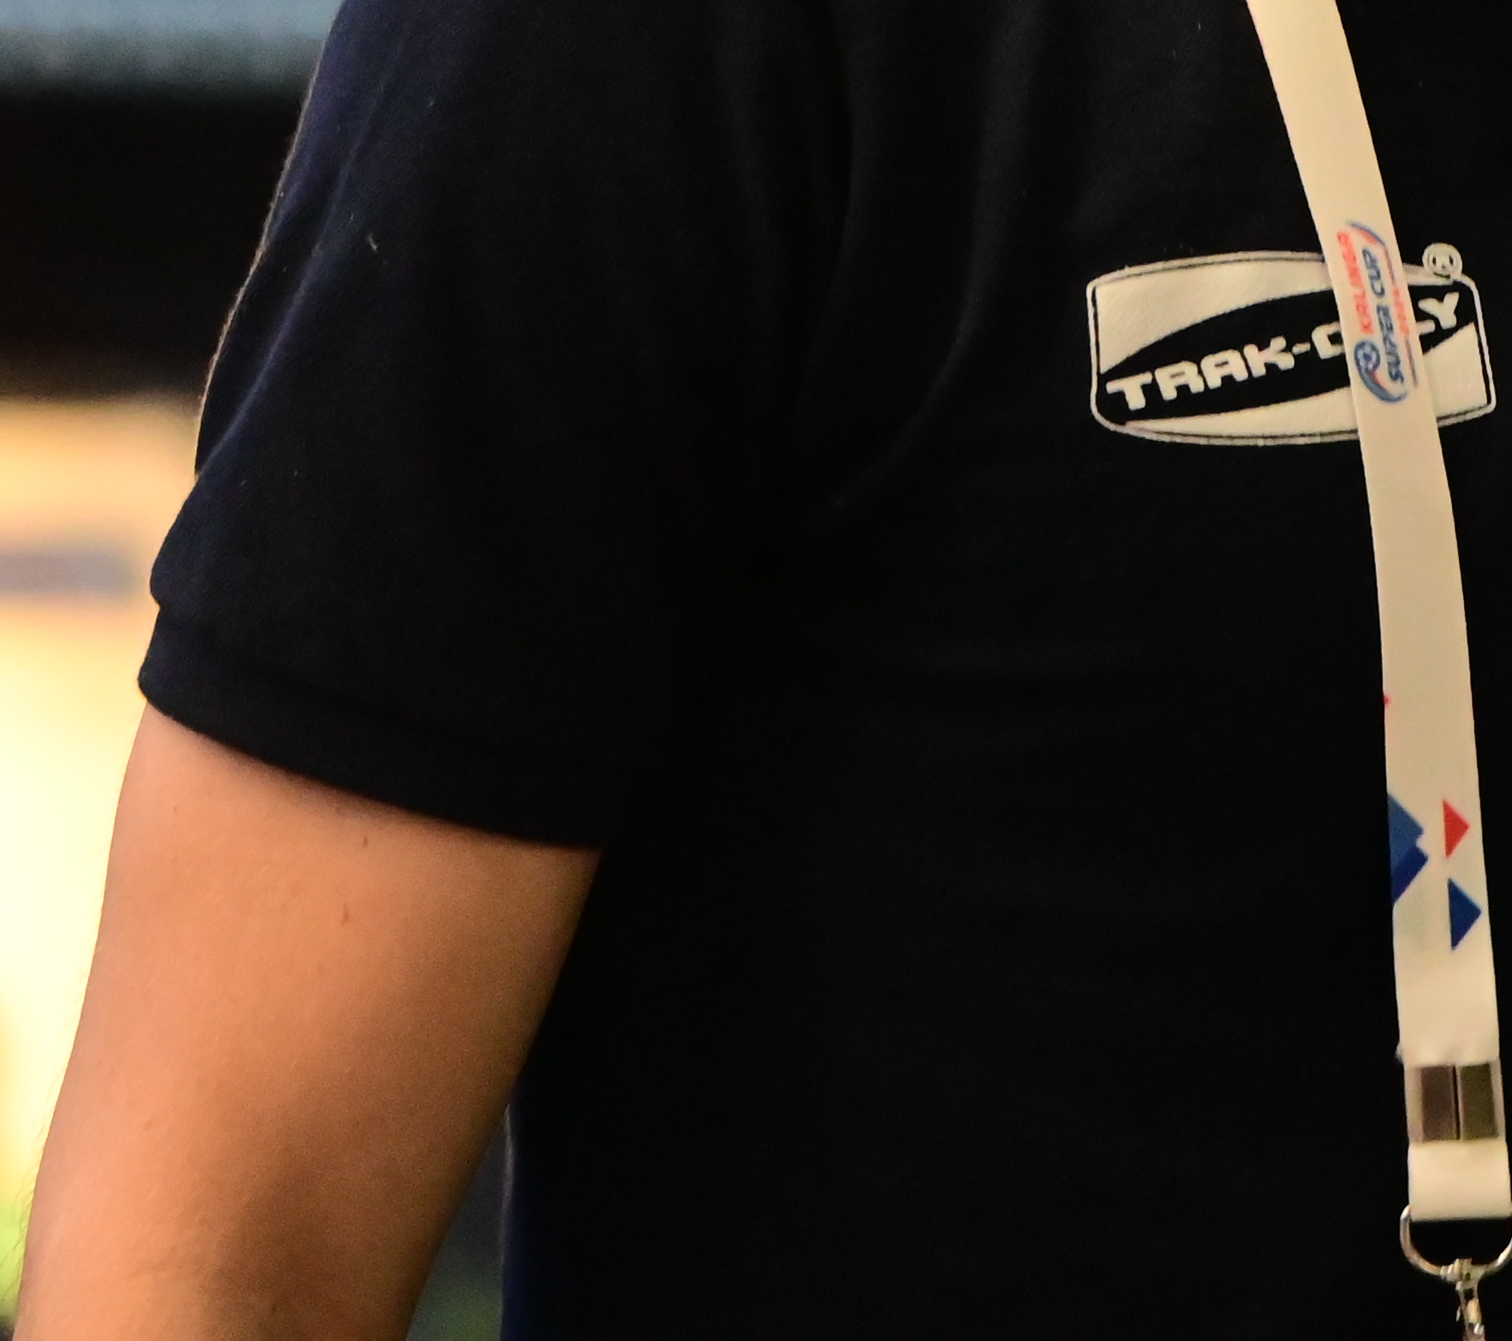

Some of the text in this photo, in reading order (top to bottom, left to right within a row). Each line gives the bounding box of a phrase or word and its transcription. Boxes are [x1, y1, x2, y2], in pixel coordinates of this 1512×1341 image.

[1362, 246, 1386, 299] CUP
[1106, 291, 1461, 412] TRAK-OY
[1377, 303, 1405, 385] SUPER
